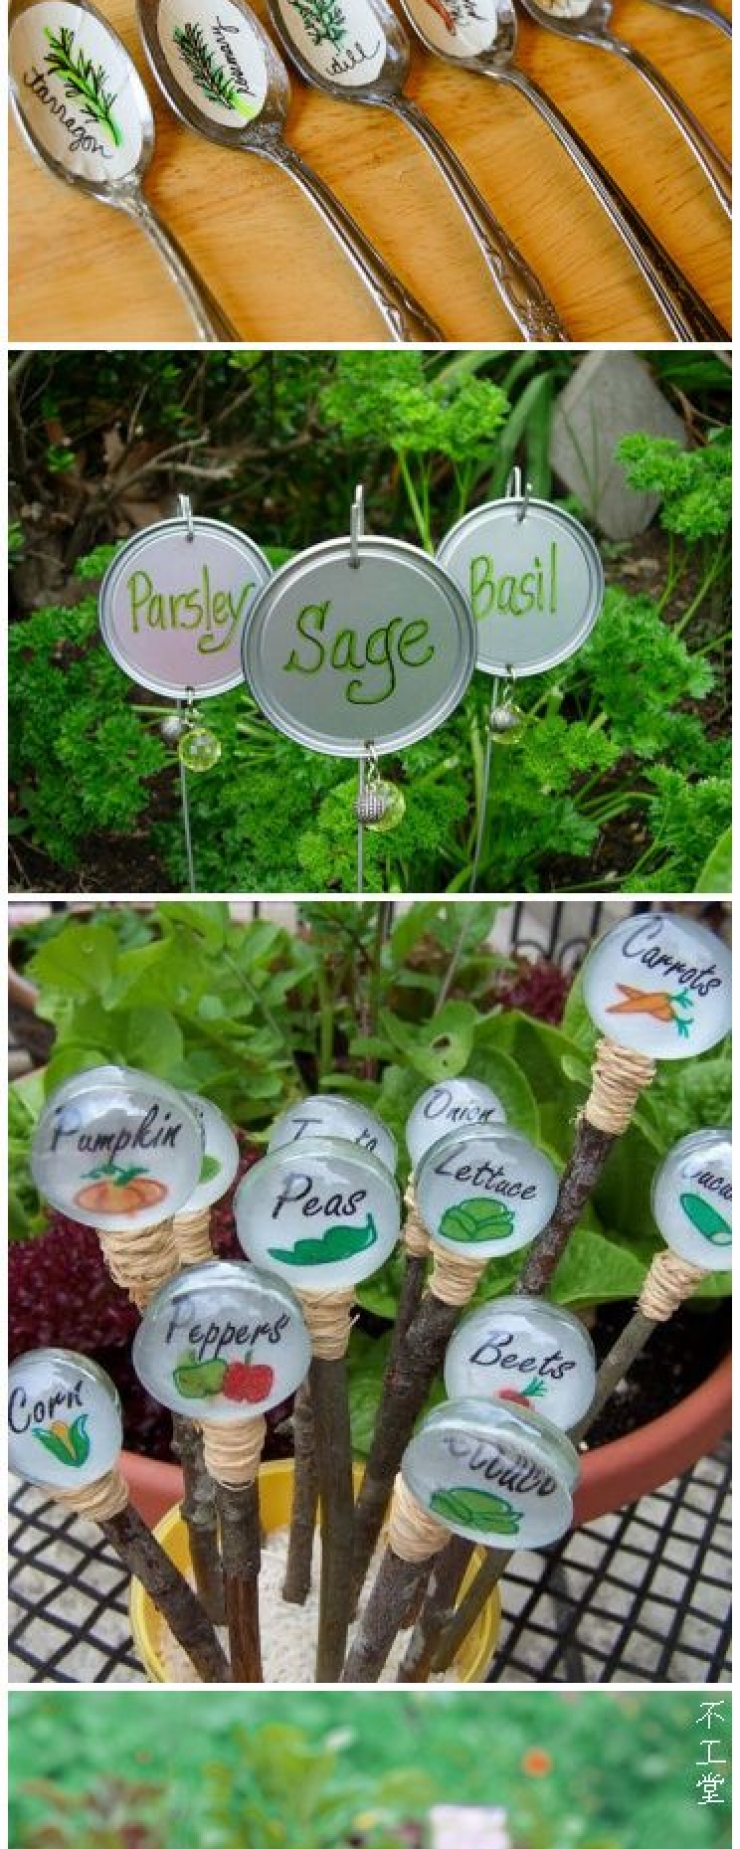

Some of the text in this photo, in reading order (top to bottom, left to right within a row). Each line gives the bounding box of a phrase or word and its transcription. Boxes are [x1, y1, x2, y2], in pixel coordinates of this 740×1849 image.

[326, 40, 380, 76] dill
[23, 67, 113, 160] tarragon
[127, 563, 255, 654] Parsley
[470, 541, 559, 621] Basil
[282, 600, 434, 705] Sage
[622, 916, 722, 997] Carrots
[51, 1104, 183, 1167] Pumpkin
[272, 1172, 367, 1220] Peas
[434, 1141, 538, 1200] Lettuce
[166, 1296, 291, 1360] Peppers
[470, 1330, 578, 1379] Beets
[8, 1380, 83, 1434] Corn
